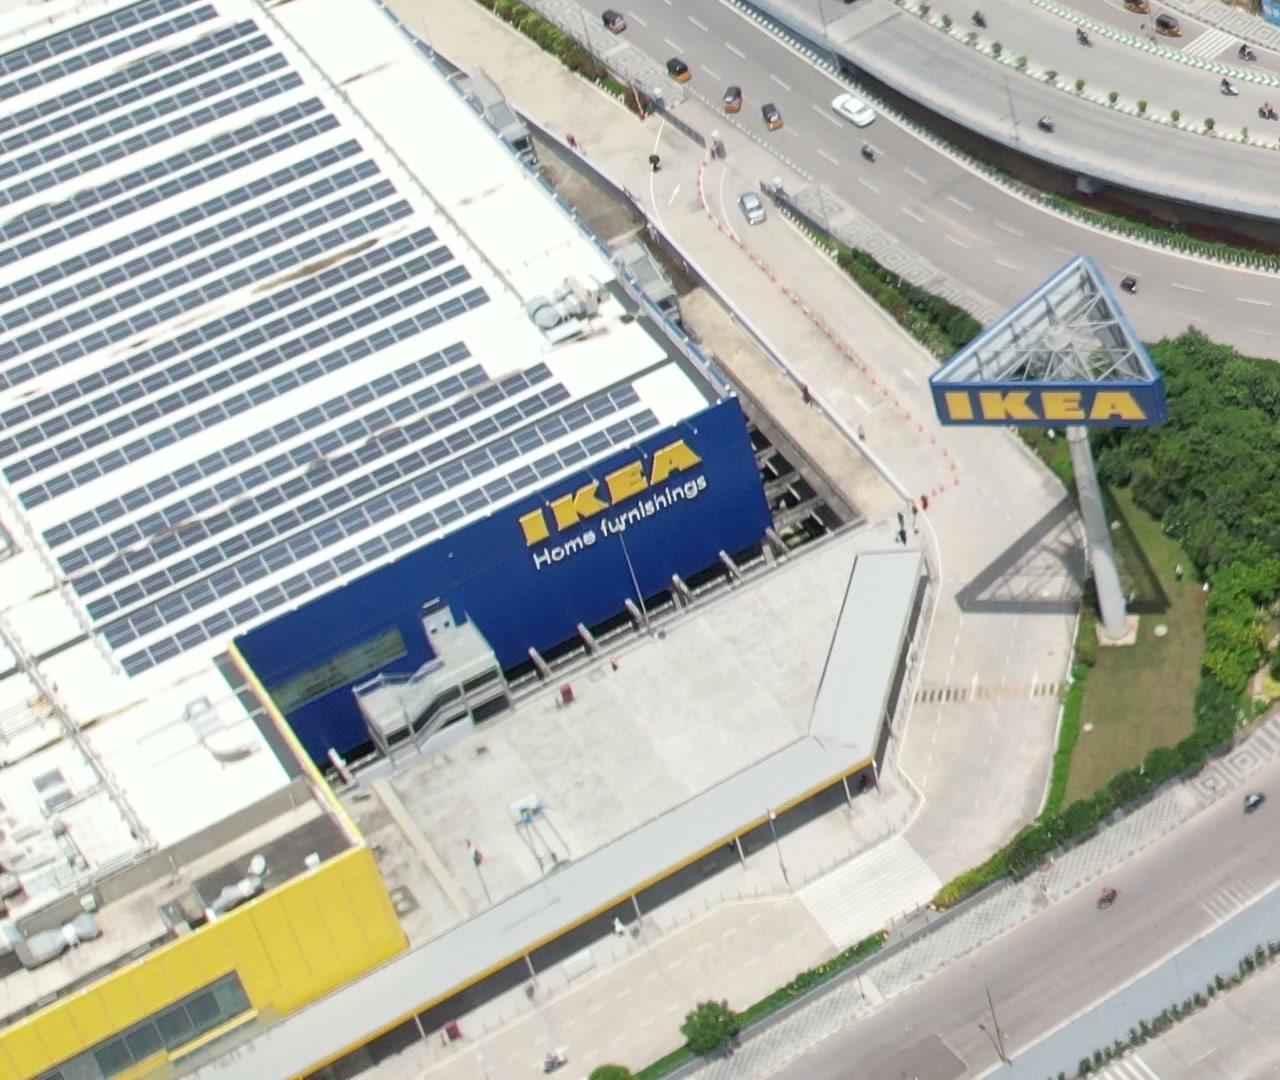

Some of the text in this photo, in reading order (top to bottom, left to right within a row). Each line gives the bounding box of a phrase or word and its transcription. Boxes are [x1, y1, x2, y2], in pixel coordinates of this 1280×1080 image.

[944, 391, 1148, 420] IKEA
[518, 439, 702, 547] IKEA
[533, 475, 707, 571] Home furnishings
